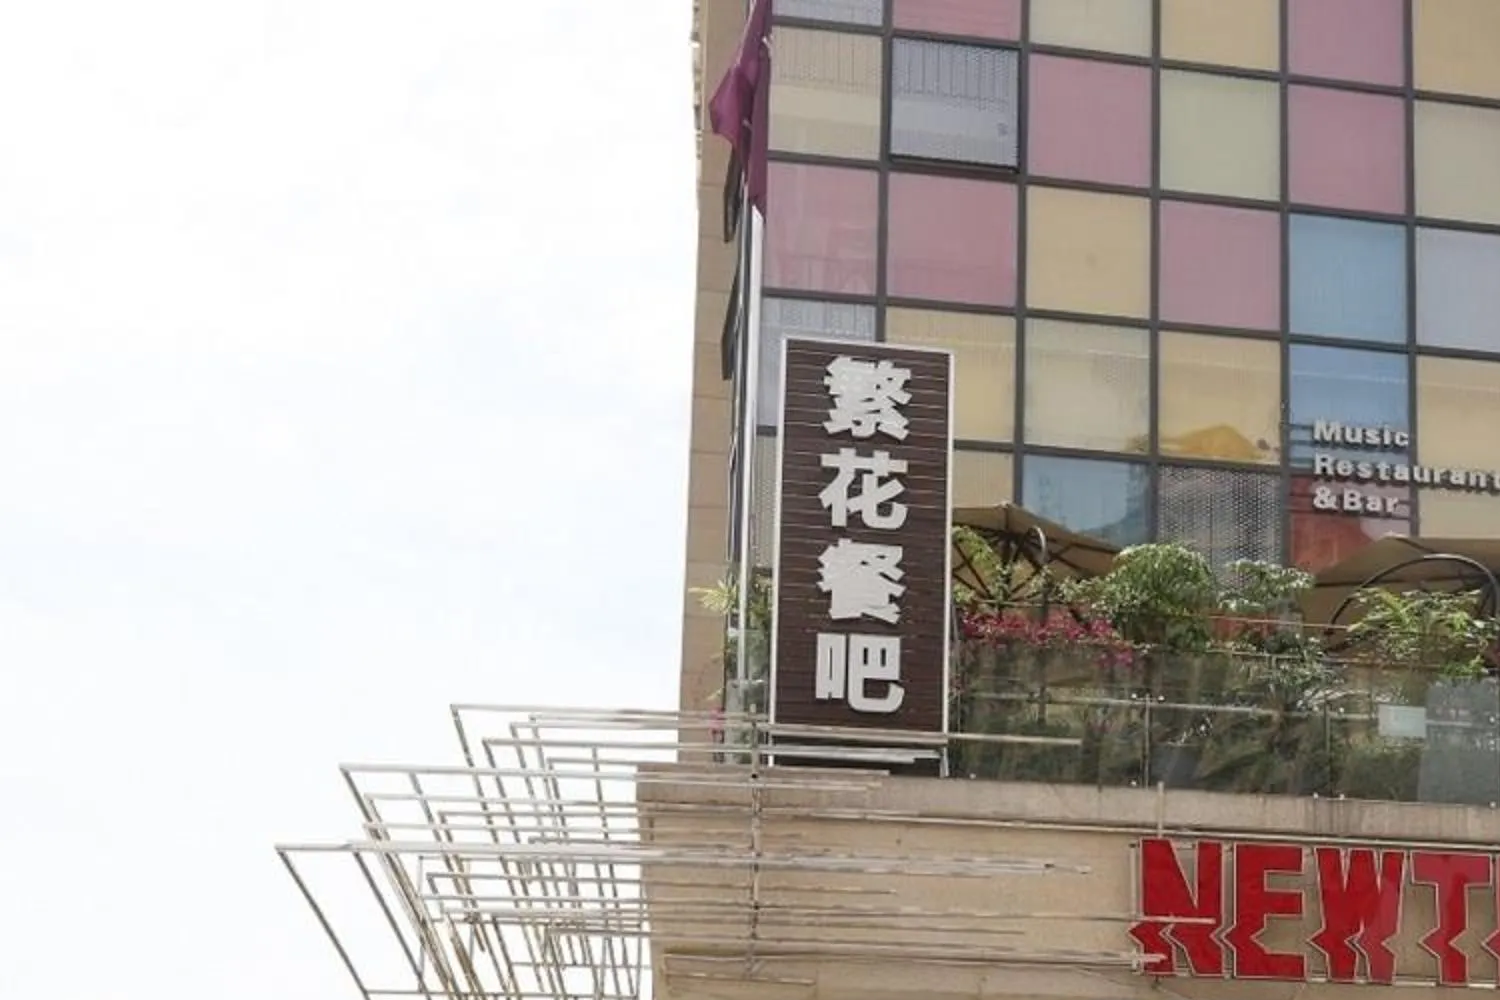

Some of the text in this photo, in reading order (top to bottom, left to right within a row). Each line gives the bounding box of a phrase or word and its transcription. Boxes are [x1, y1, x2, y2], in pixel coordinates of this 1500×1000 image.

[1314, 419, 1409, 446] Music
[815, 355, 913, 713] 繁花餐吧
